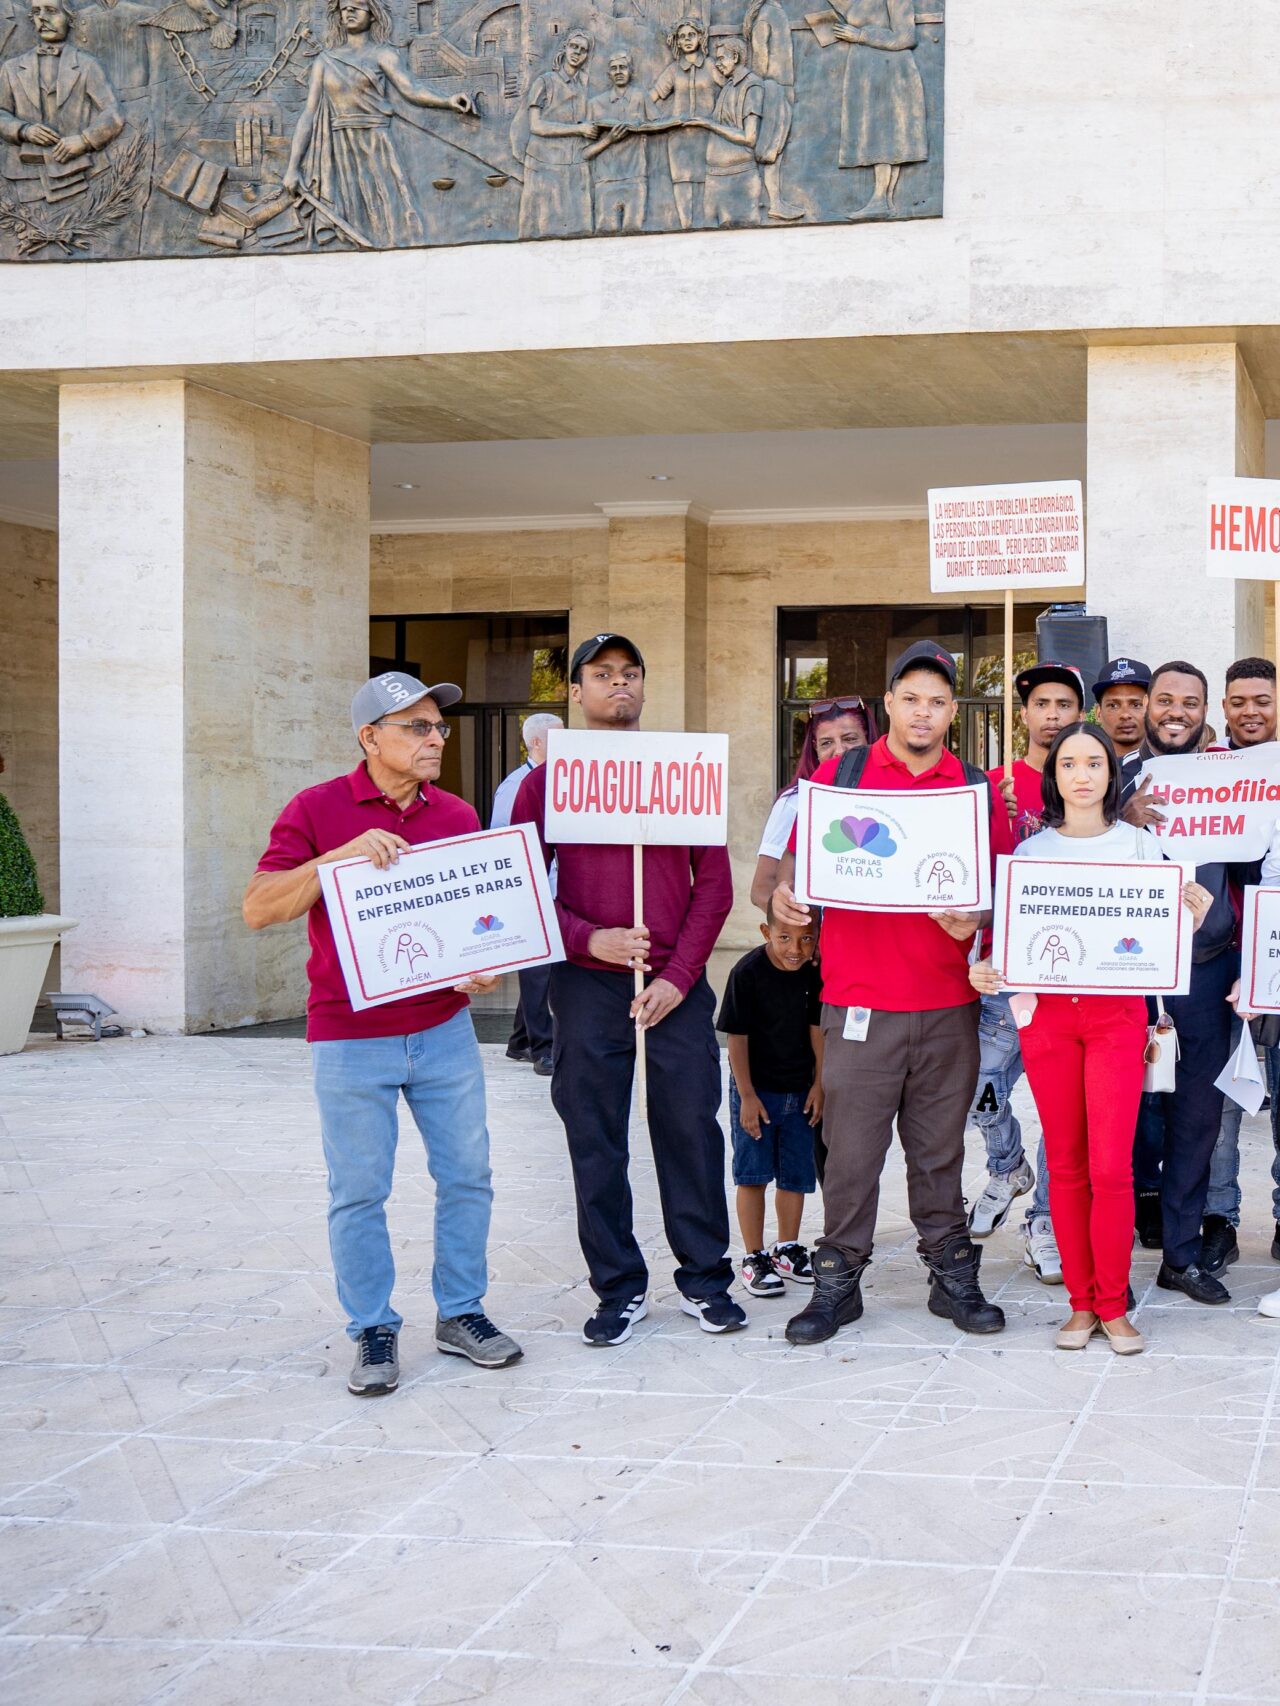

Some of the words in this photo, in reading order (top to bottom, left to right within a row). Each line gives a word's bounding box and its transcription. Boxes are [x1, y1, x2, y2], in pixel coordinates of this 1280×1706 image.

[935, 504, 942, 519] LA
[944, 501, 976, 518] HEMOFILIA
[977, 501, 984, 516] ES
[986, 500, 994, 516] UN
[996, 498, 1028, 515] PROBLEMA
[1030, 493, 1075, 513] HEMORRÁGICO.
[933, 522, 944, 539] LAS
[946, 520, 976, 538] PERSONAS
[978, 520, 990, 536] CON
[991, 519, 1023, 535] HEMOFILIA
[1025, 518, 1033, 533] NO
[1035, 516, 1063, 533] SANGRAN
[959, 542, 966, 557] DE
[968, 541, 975, 556] LO
[1006, 539, 1022, 554] PERO
[1023, 538, 1047, 553] PUEDEN
[1050, 536, 1079, 552] SANGRAR
[947, 561, 974, 577] DURANTE
[553, 752, 722, 815] COAGULACIÓN
[355, 874, 435, 901] APOYEMOS
[440, 869, 458, 882] LA
[462, 863, 488, 877] LEY
[495, 858, 512, 871] DE
[836, 864, 883, 878] RARAS
[358, 887, 471, 921] ENFERMEDADES
[475, 876, 523, 895] RARAS
[1022, 885, 1093, 897] APOYEMOS
[1099, 888, 1114, 898] LA
[1120, 888, 1143, 898] LEY
[1149, 889, 1164, 899] DE
[1020, 904, 1121, 916] ENFERMEDADES
[1127, 907, 1169, 918] RARAS
[400, 972, 432, 985] FAHEM
[1039, 974, 1067, 982] FAHEM
[976, 1081, 999, 1112] A
